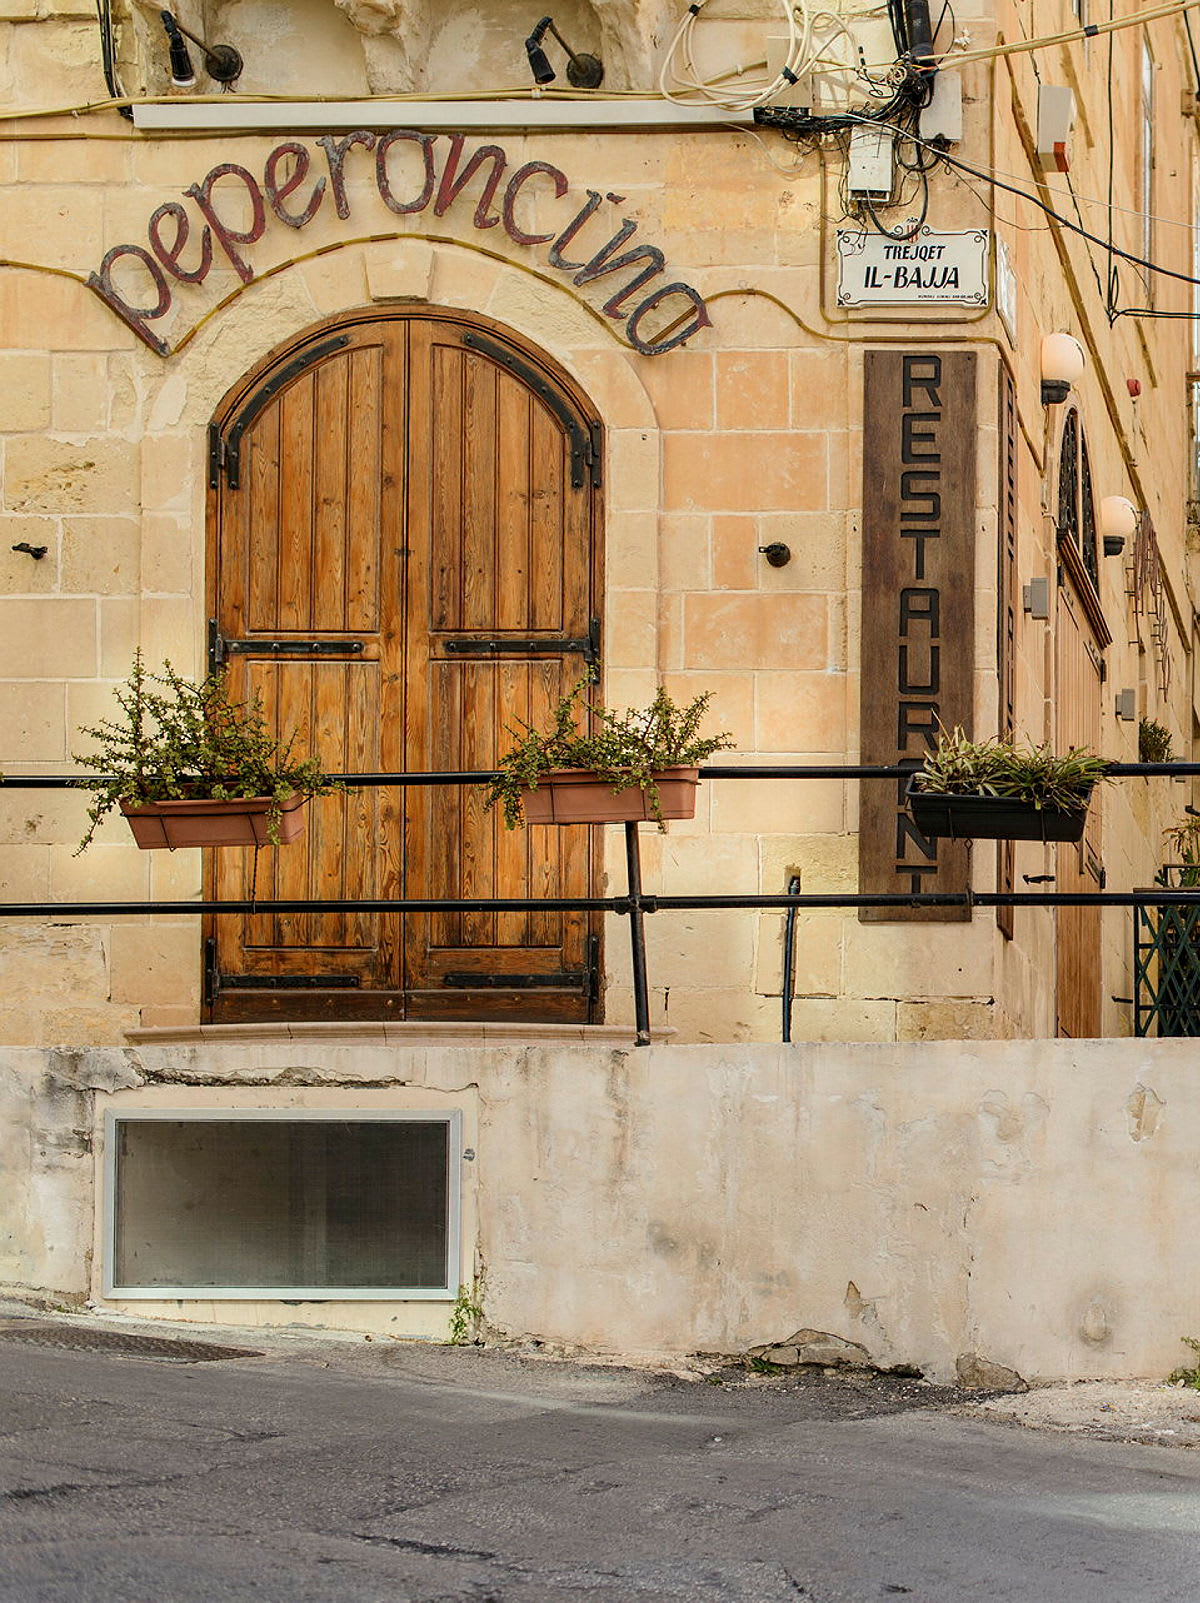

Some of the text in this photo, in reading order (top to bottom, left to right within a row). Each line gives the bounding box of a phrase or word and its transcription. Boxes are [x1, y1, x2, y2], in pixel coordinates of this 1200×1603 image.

[84, 130, 713, 358] peperoncino
[883, 245, 946, 260] TREJQET
[864, 266, 960, 289] IL-BAJJA
